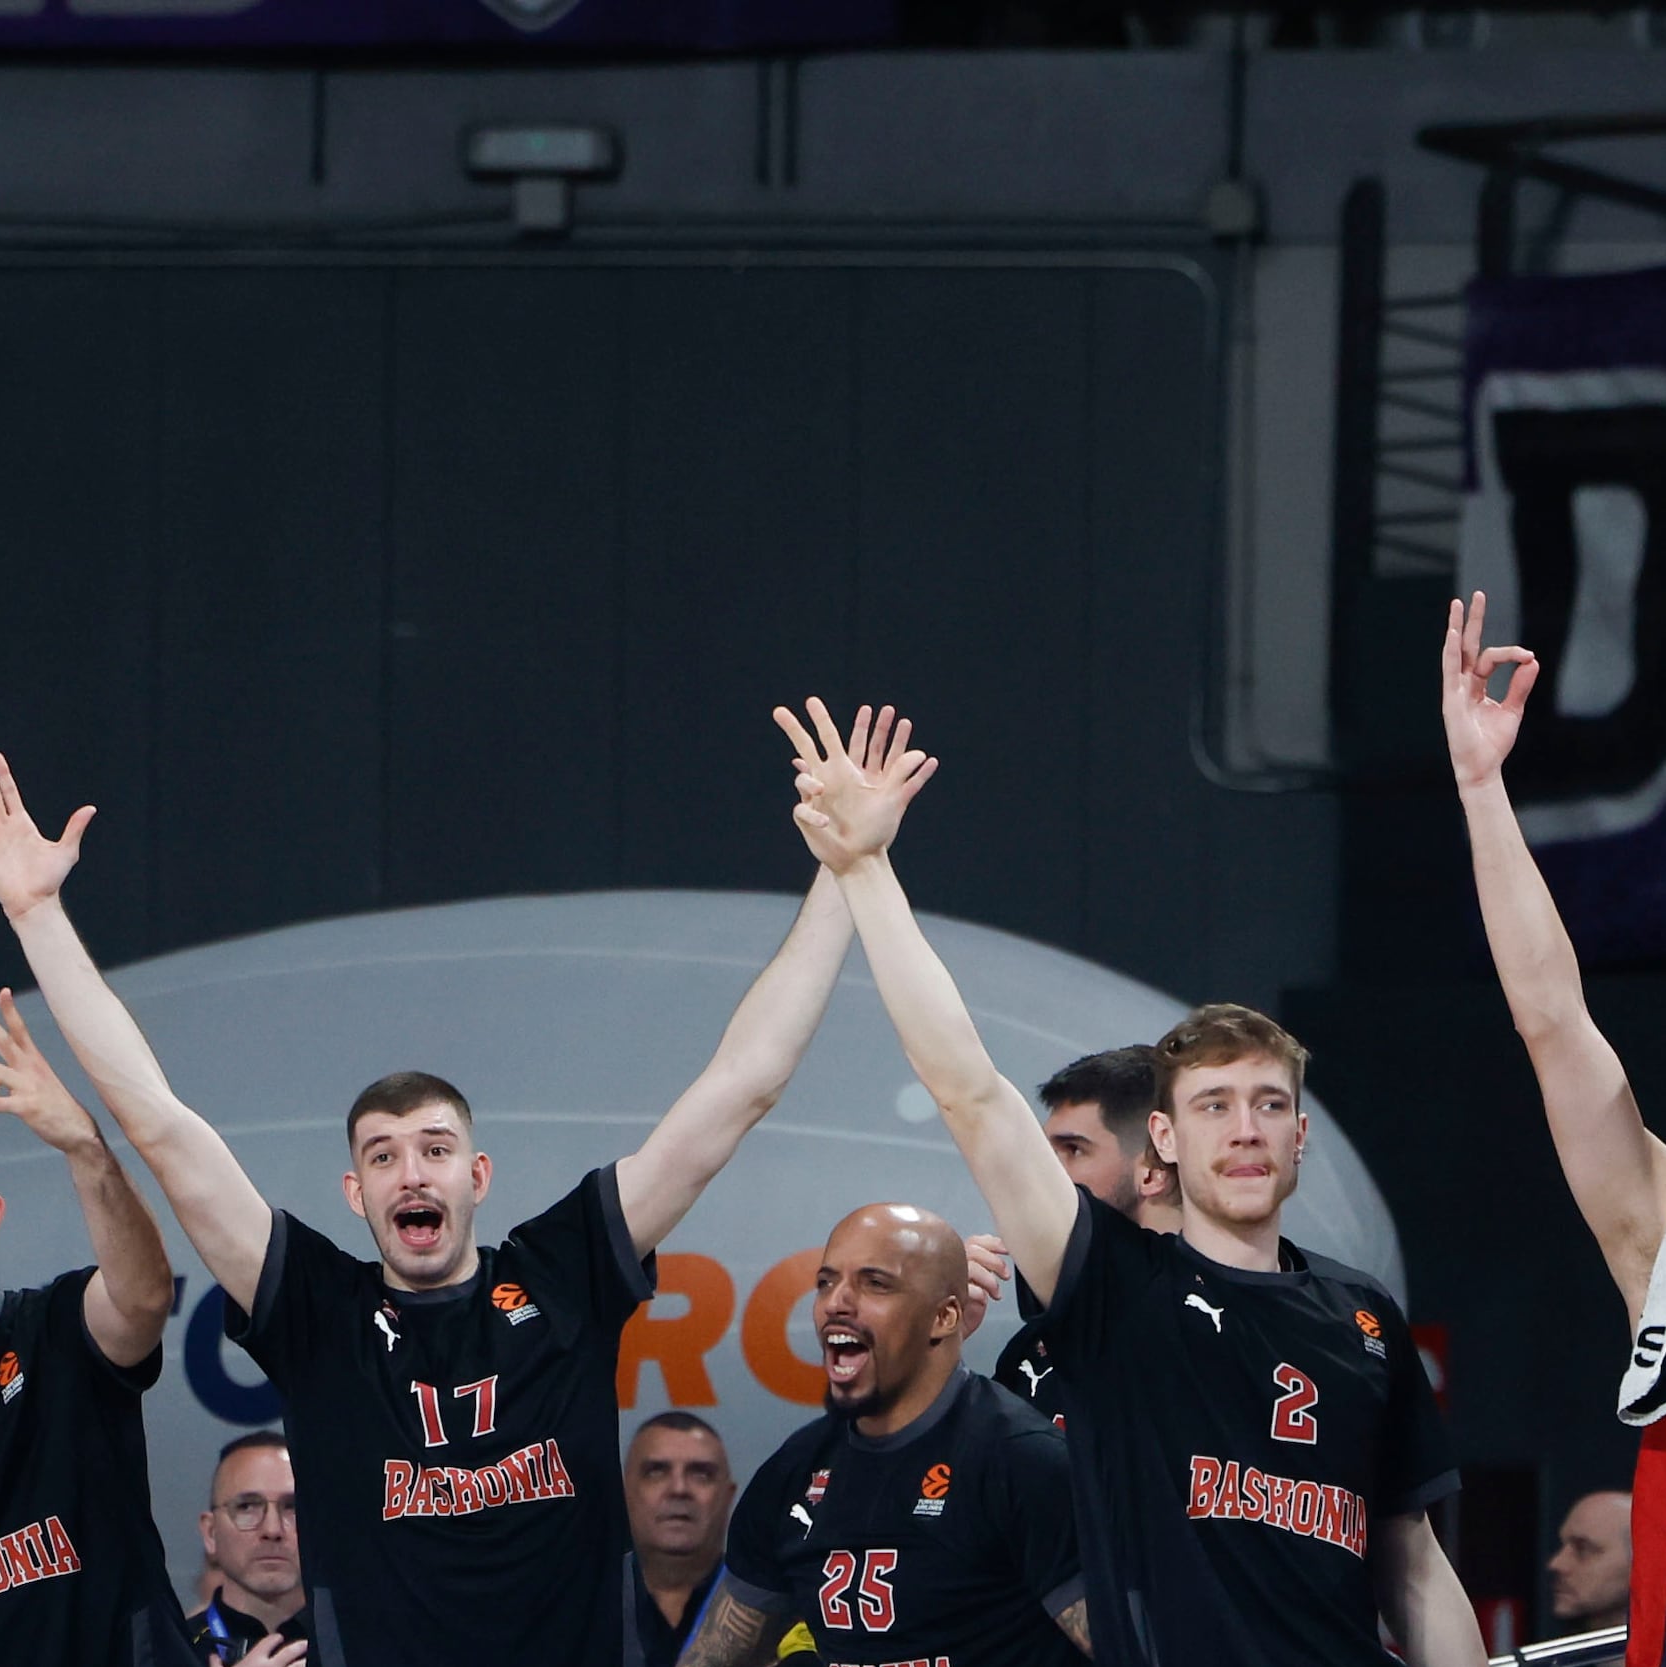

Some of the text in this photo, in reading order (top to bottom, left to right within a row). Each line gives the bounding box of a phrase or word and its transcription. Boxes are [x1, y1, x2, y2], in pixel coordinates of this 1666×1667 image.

[410, 1374, 498, 1448] 17
[1271, 1362, 1319, 1445] 2
[383, 1438, 575, 1521] BASKONIA
[1186, 1455, 1367, 1560] BASKONIA
[819, 1549, 898, 1632] 25
